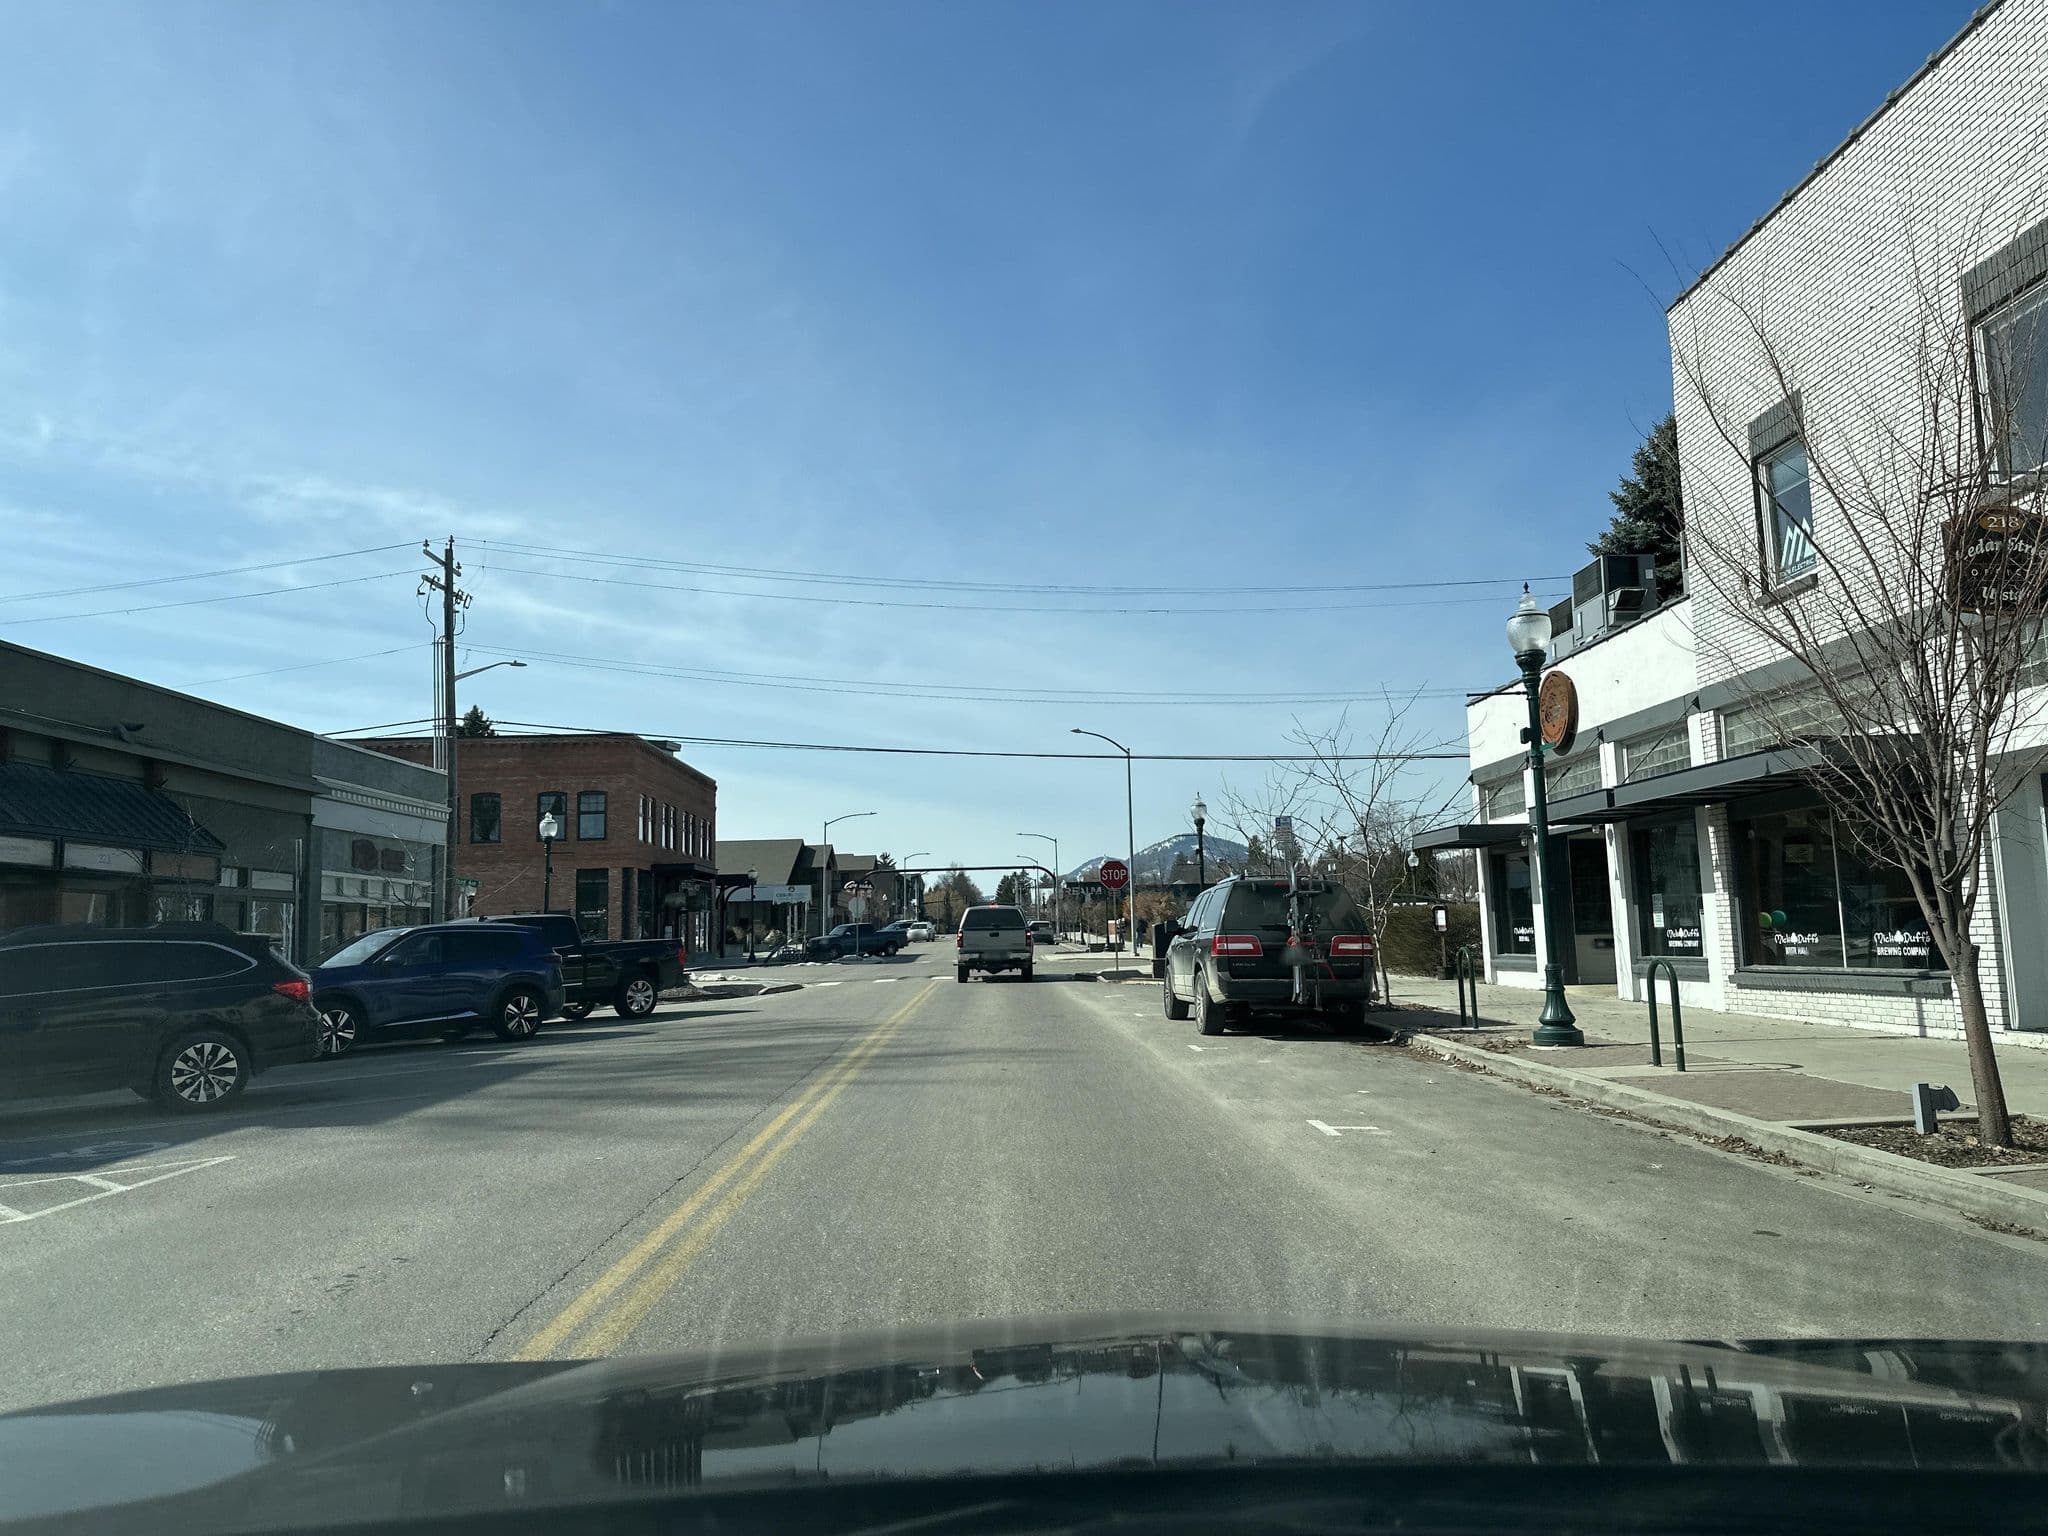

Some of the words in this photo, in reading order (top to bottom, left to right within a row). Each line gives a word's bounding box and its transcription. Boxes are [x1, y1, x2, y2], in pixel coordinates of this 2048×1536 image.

[1986, 516, 2019, 528] 218
[1956, 538, 2003, 562] edar
[1101, 869, 1127, 881] STOP
[1873, 931, 1895, 946] Mick
[1903, 931, 1931, 944] Duff's
[1877, 946, 1902, 956] BREWING
[1902, 946, 1930, 956] COMPANY
